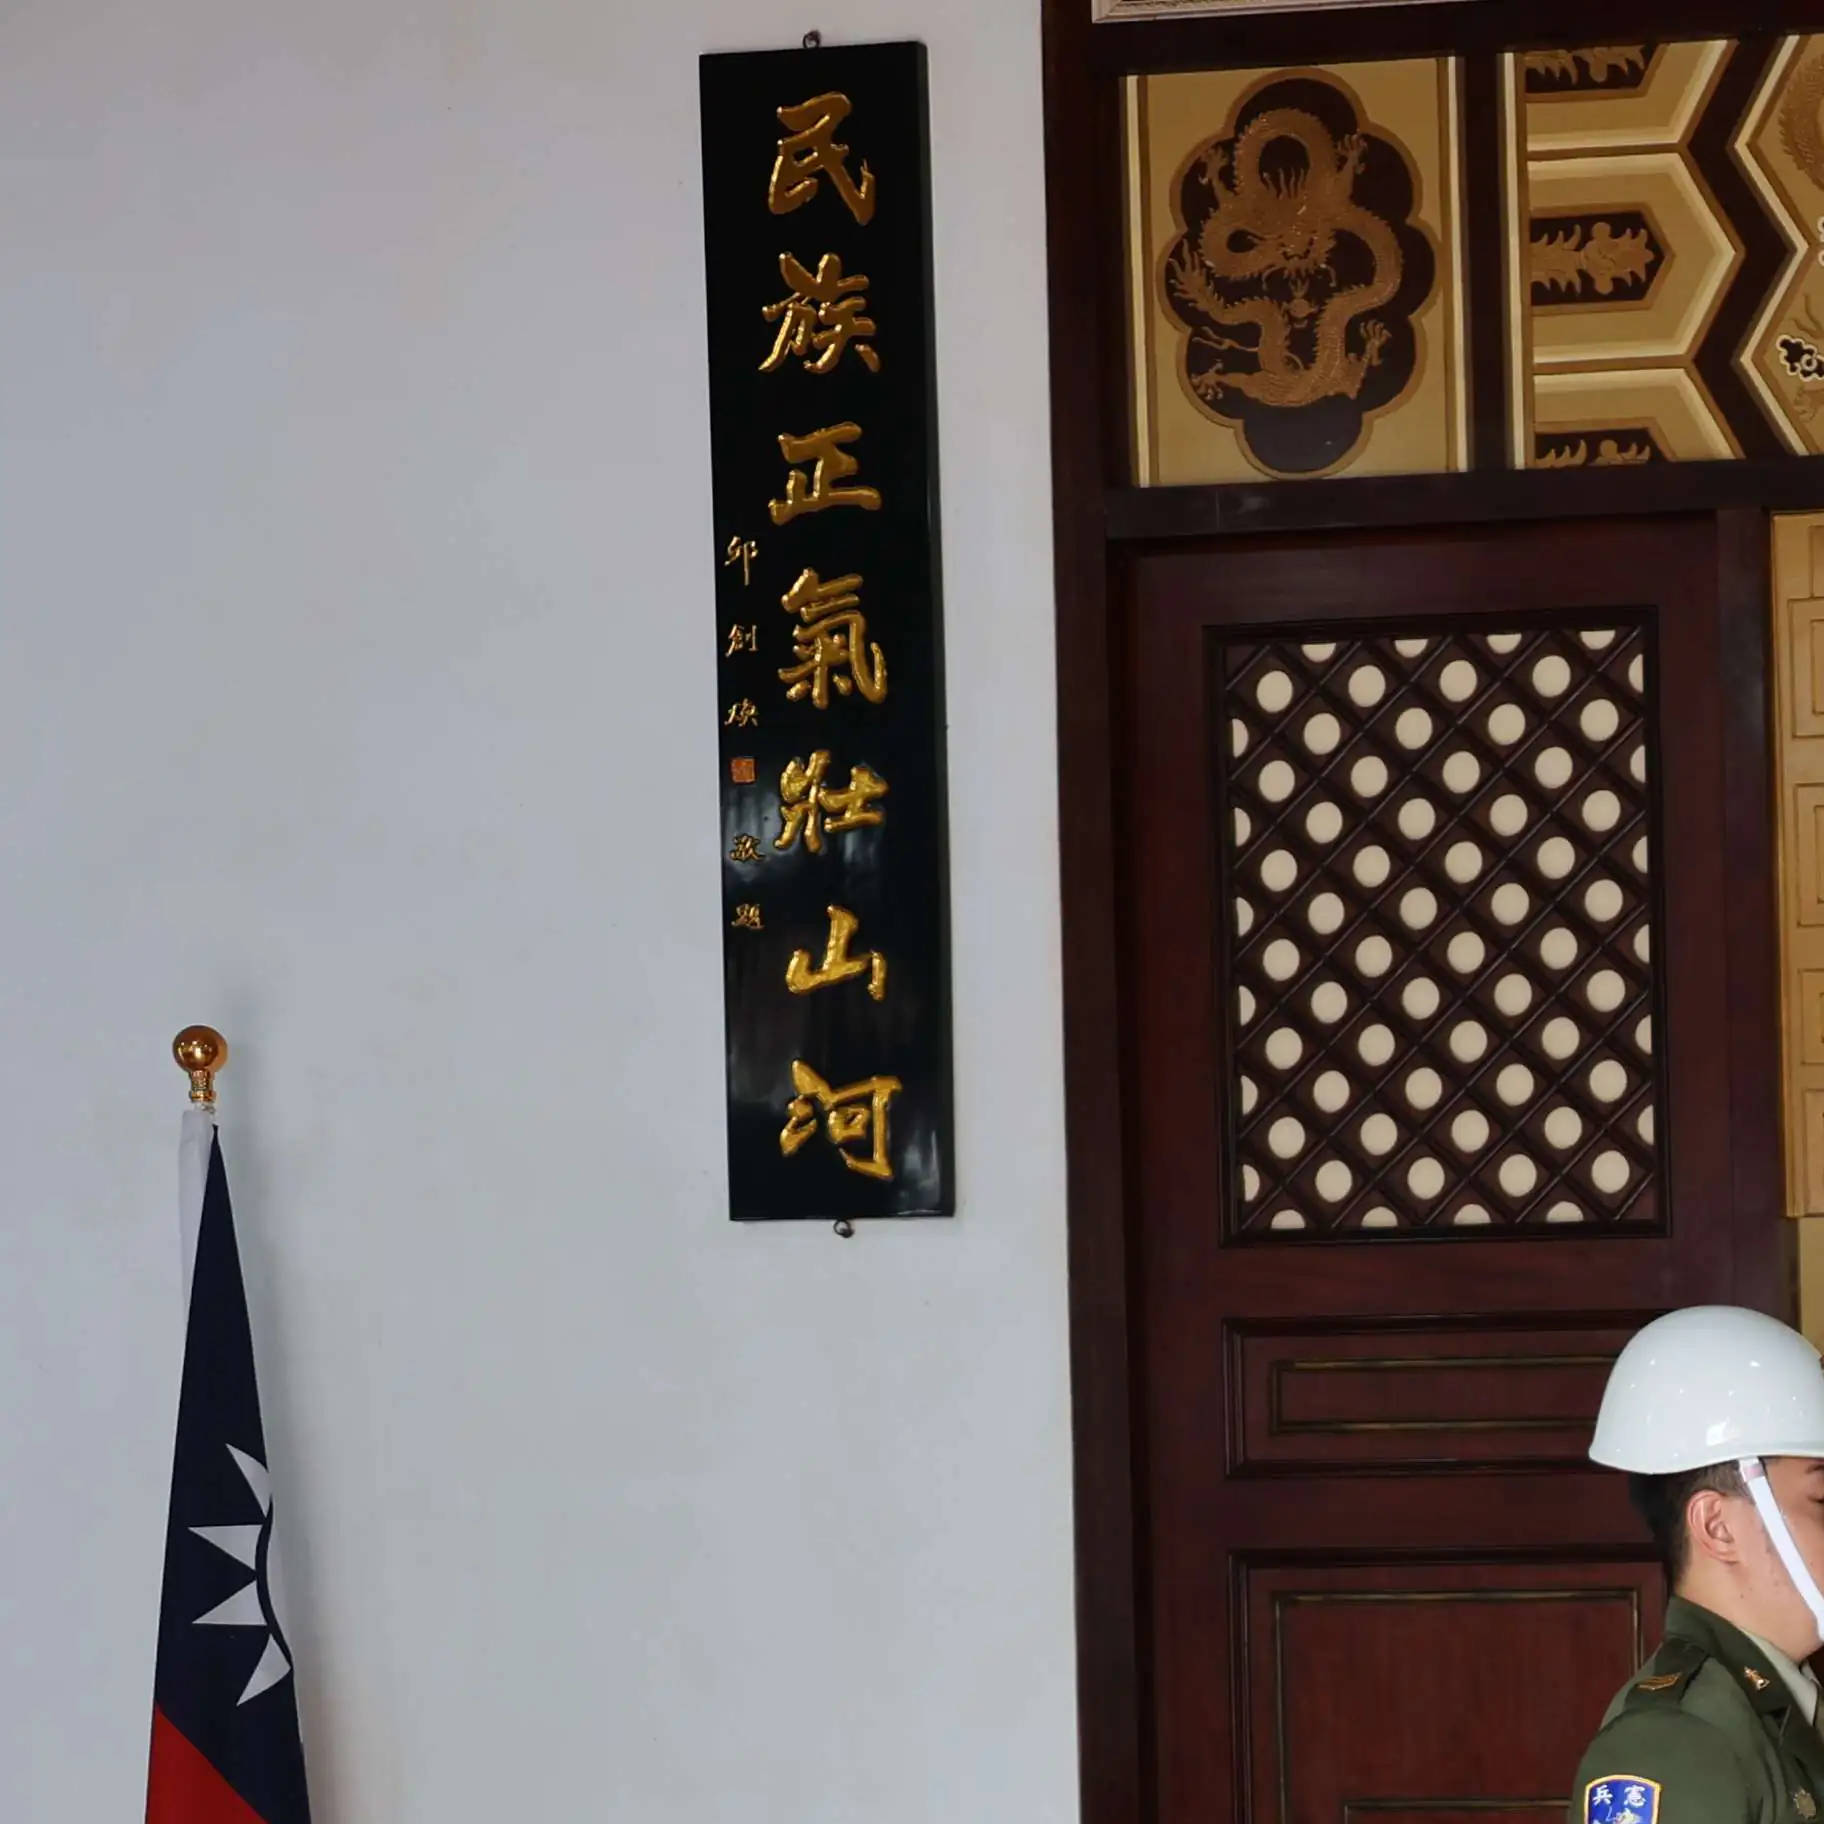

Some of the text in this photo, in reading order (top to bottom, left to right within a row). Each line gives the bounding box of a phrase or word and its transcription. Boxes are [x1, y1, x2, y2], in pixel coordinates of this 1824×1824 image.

[757, 92, 903, 1182] 民族正氣壯山河
